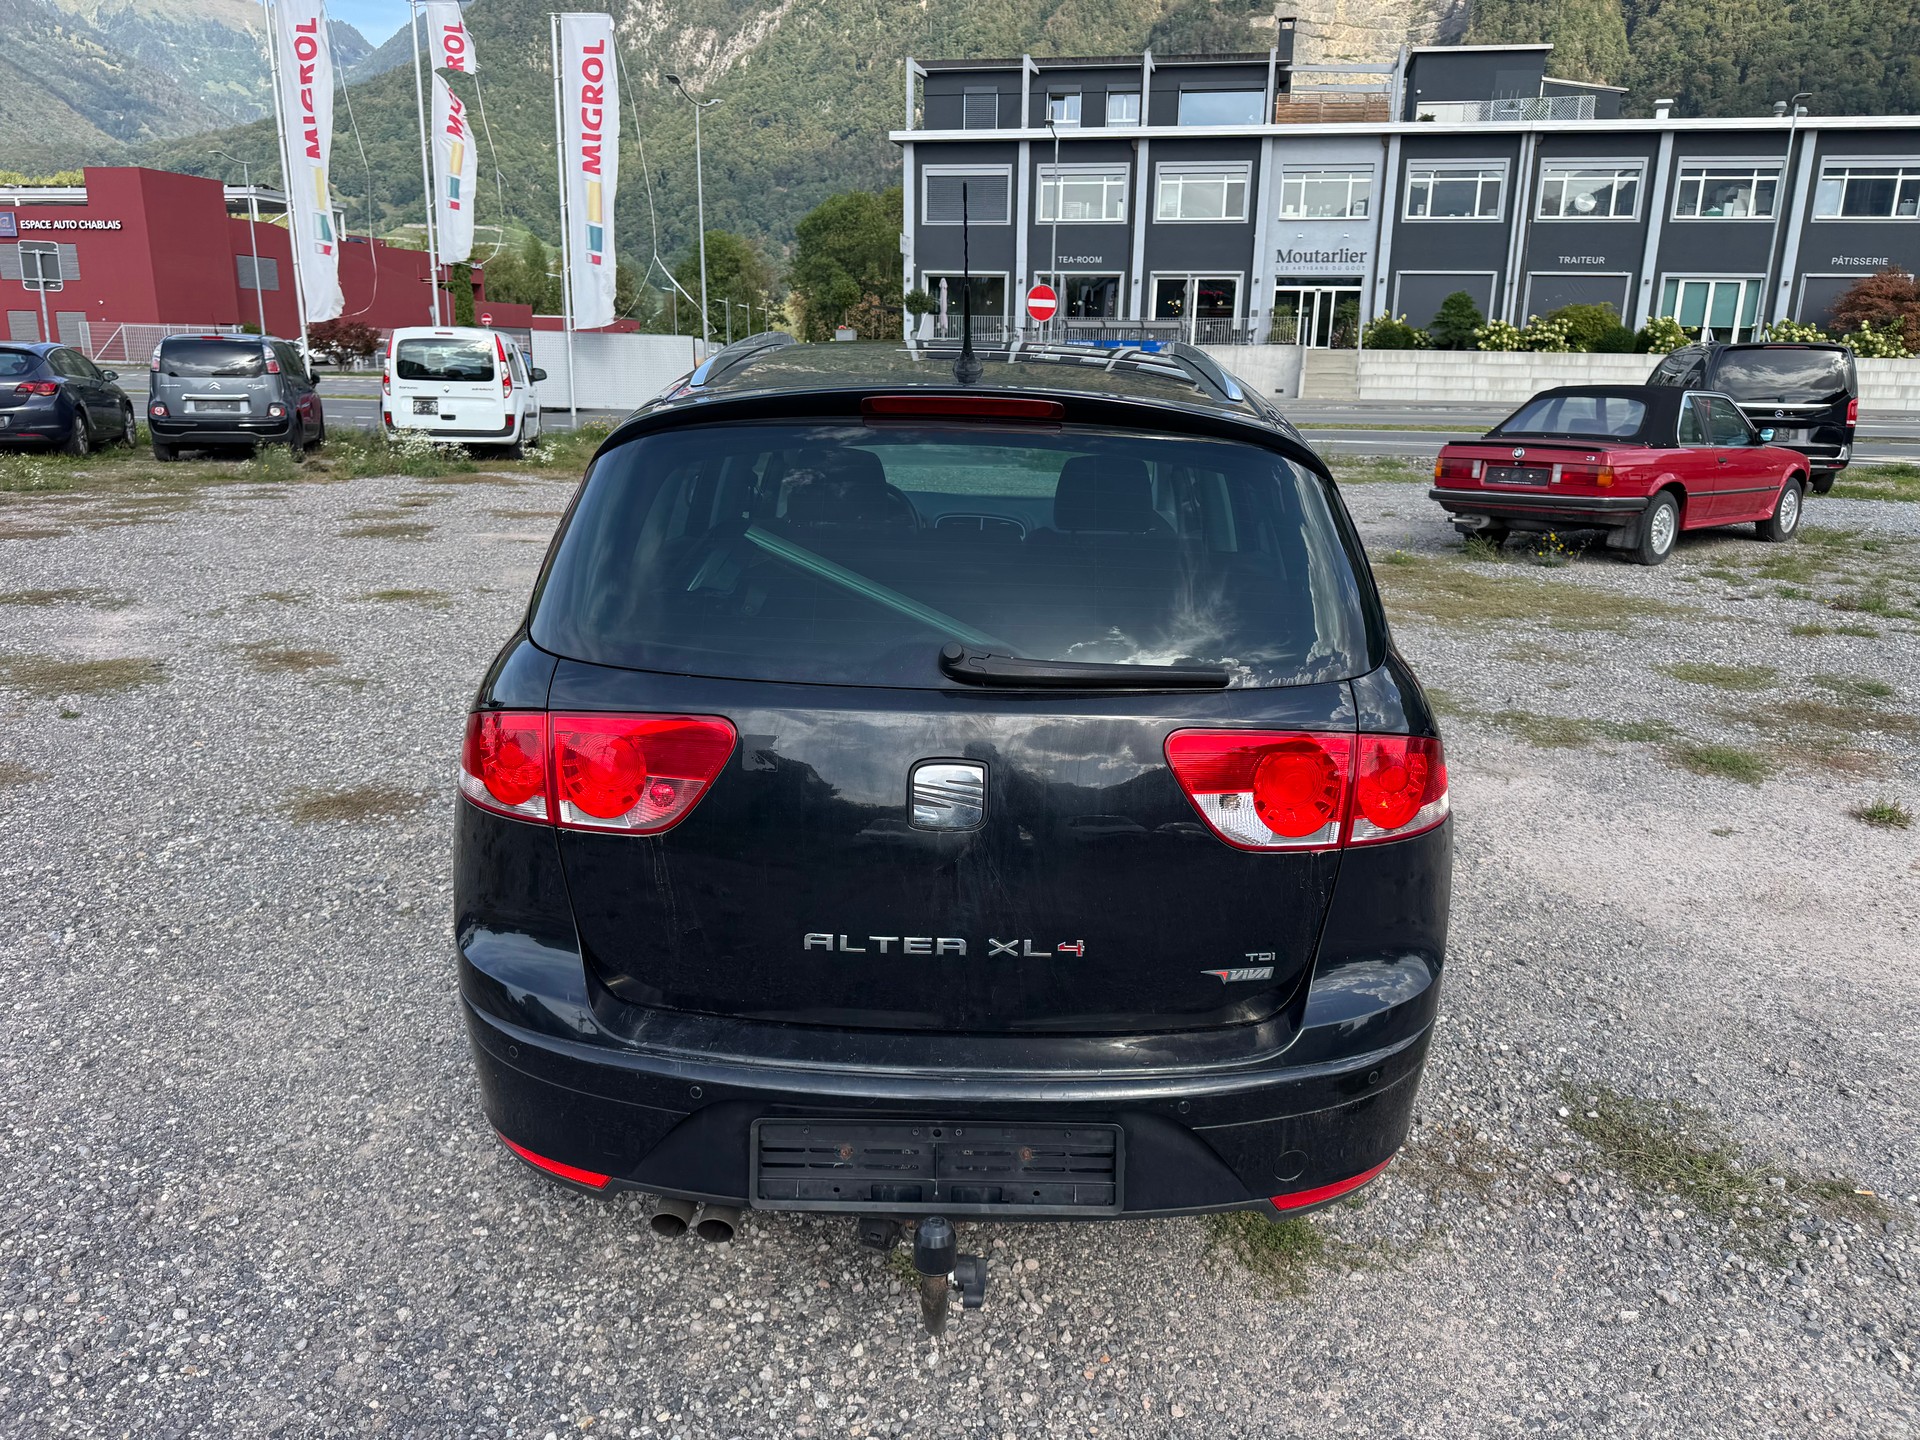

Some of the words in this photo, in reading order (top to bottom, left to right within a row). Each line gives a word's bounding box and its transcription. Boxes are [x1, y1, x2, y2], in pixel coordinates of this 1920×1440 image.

[581, 39, 605, 176] MIGROL
[20, 220, 52, 229] ESPACE
[53, 220, 77, 229] AUTO
[78, 220, 122, 229] CHABLAIS
[1057, 256, 1103, 264] TEA-ROOM
[1275, 248, 1368, 264] Moutarlier
[1558, 256, 1606, 265] TRAITEUR
[1831, 255, 1889, 266] PÂTISSERIE
[1230, 968, 1271, 980] VIVA
